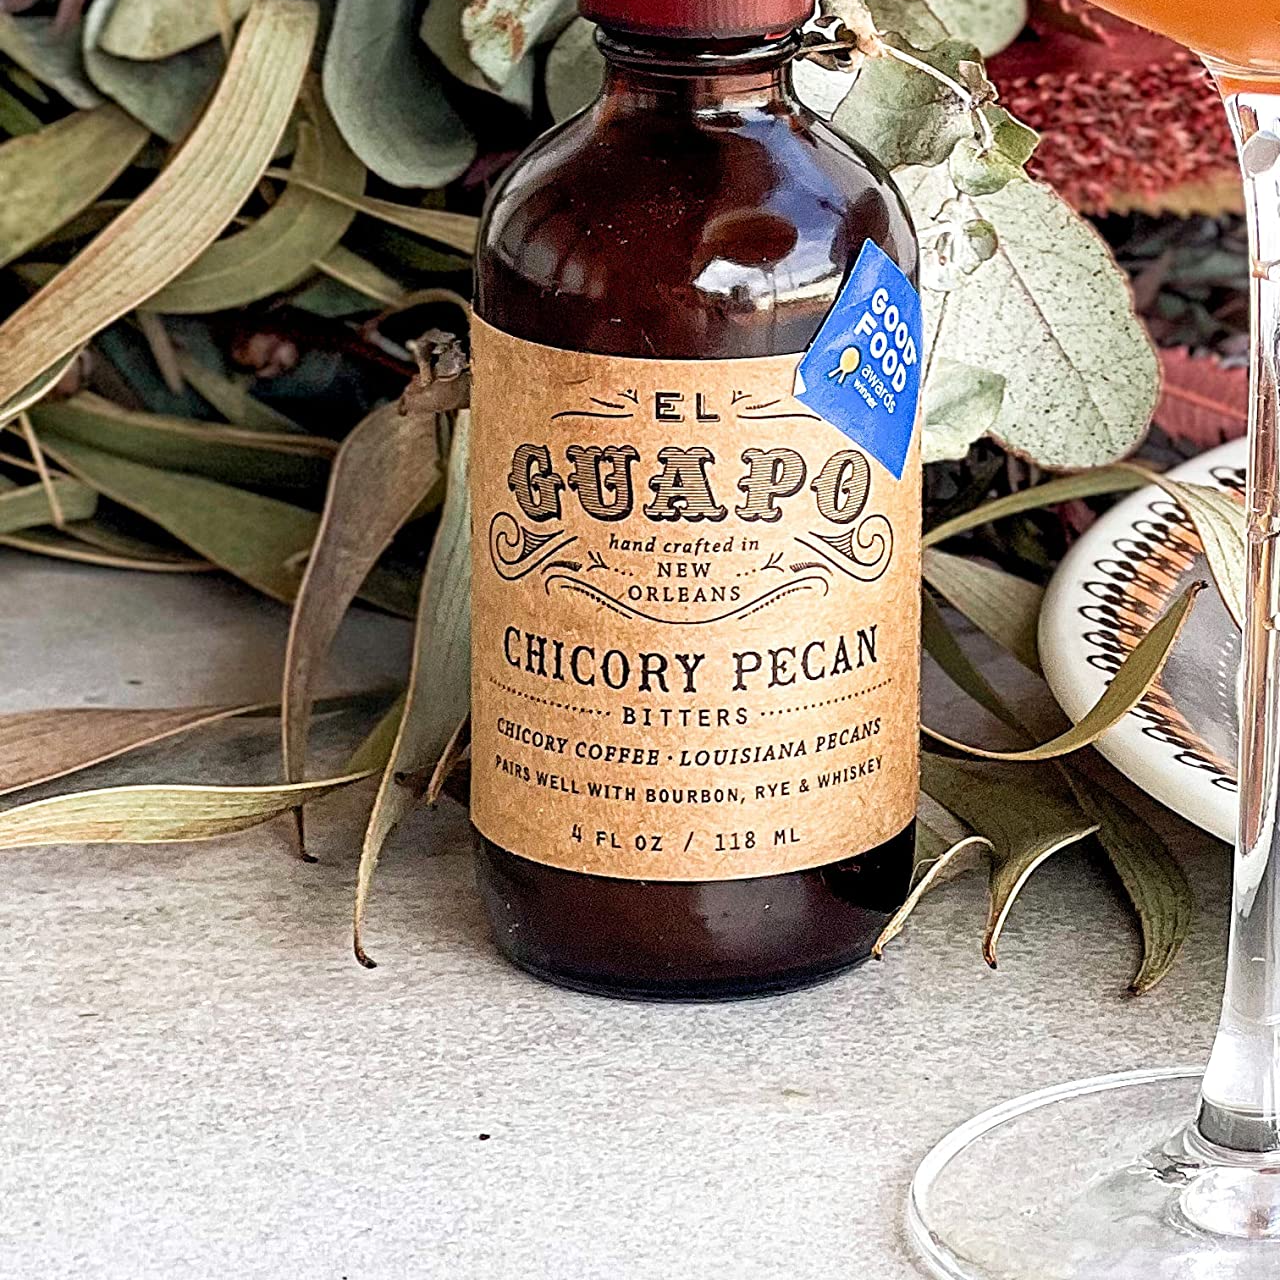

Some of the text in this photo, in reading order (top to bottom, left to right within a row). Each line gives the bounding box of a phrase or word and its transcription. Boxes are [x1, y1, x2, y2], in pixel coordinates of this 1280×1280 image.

[872, 288, 917, 365] GOOD
[854, 312, 906, 393] FOOD
[656, 392, 721, 422] EL
[854, 379, 878, 410] winner
[862, 364, 897, 414] awards
[508, 444, 871, 524] GUAPO
[608, 534, 759, 554] hand crafted in
[657, 562, 711, 578] NEW
[628, 586, 741, 603] ORLEANS
[504, 625, 878, 693] CHICORY PECAN
[623, 706, 748, 727] BITTERS
[497, 717, 882, 767] CHICORY COFFEE LOUISIANA PECANS
[495, 755, 883, 805] PAIRS WELL WITH BOURBON, RYE & WHISKEY
[571, 824, 800, 852] 4 FL OZ / 118 ML
